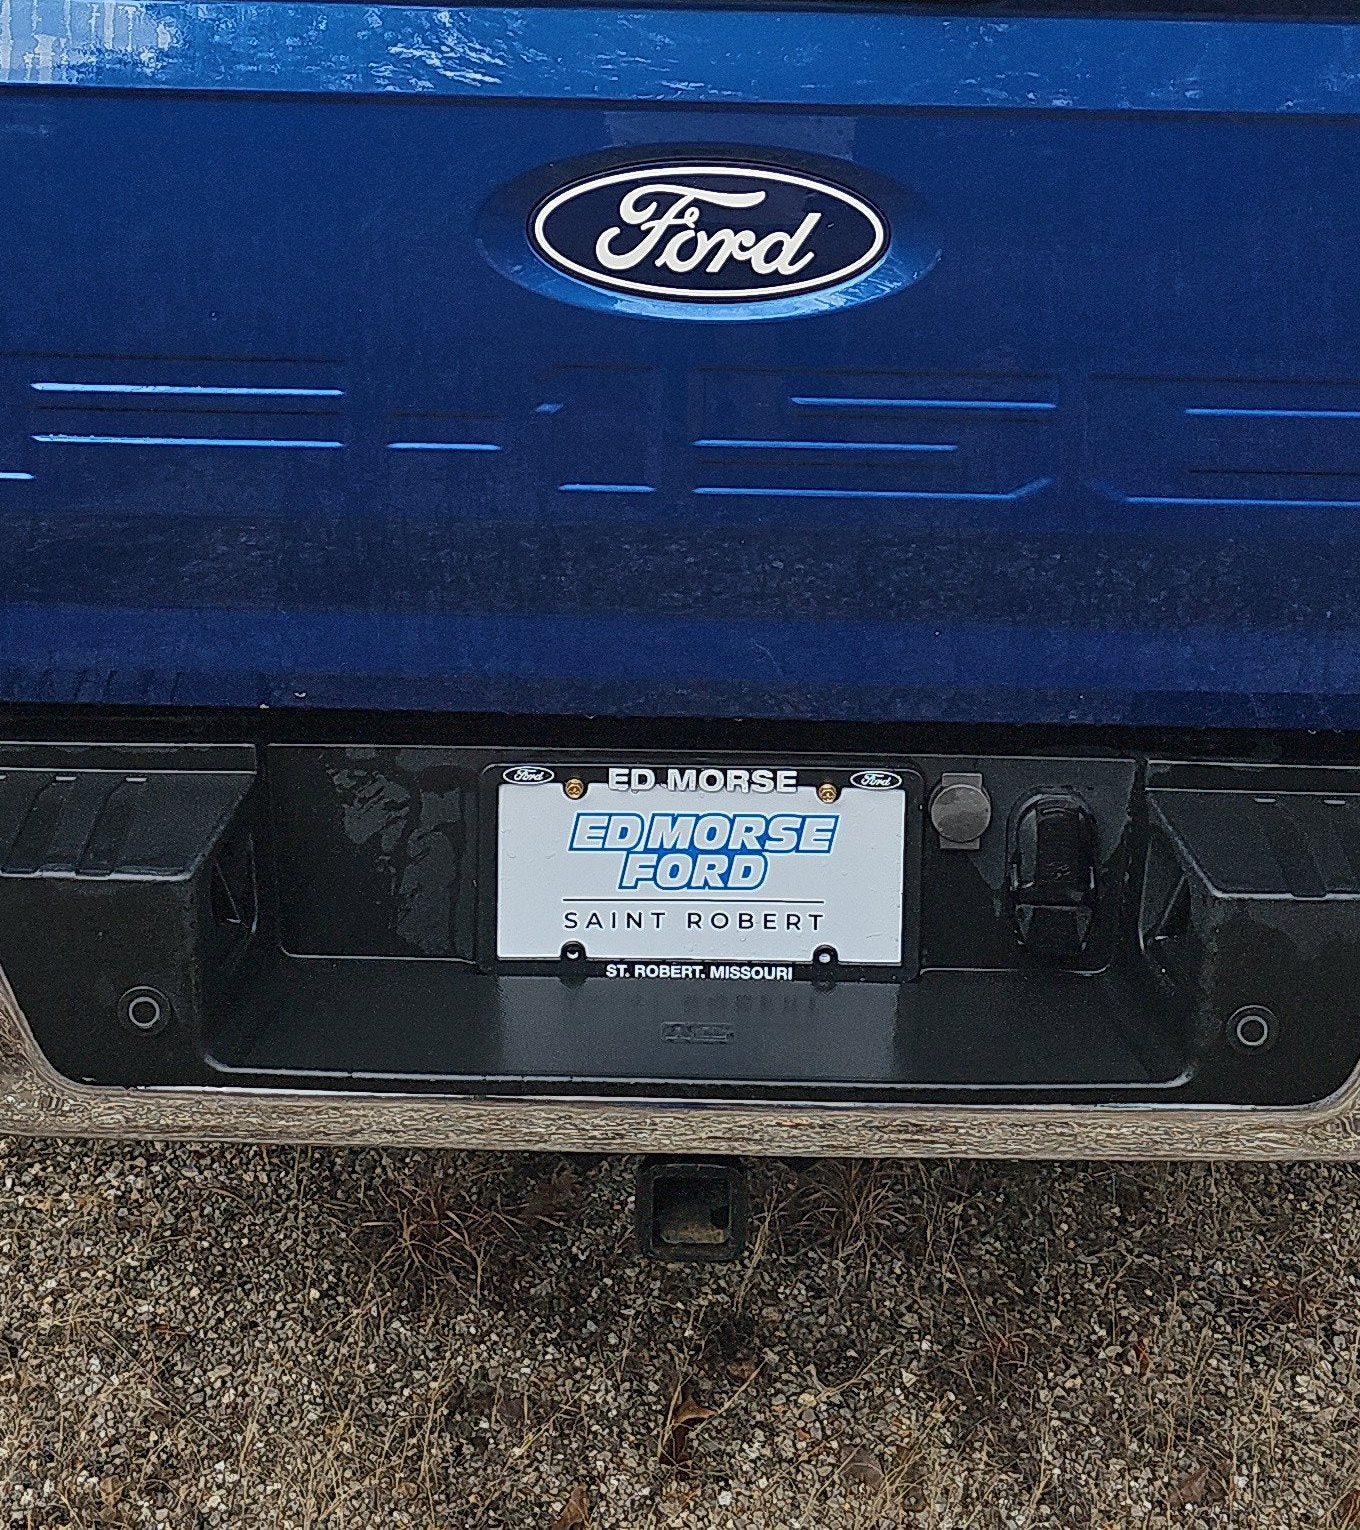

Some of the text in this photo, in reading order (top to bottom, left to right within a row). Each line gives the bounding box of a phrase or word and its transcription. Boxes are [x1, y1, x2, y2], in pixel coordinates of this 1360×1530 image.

[596, 183, 821, 276] Ford
[608, 768, 798, 793] ED MORSE
[568, 812, 839, 853] ED MORSE
[617, 851, 768, 890] FORD
[564, 912, 823, 931] SAINT ROBERT
[605, 964, 630, 978] ST.
[709, 966, 793, 981] MISSOURI
